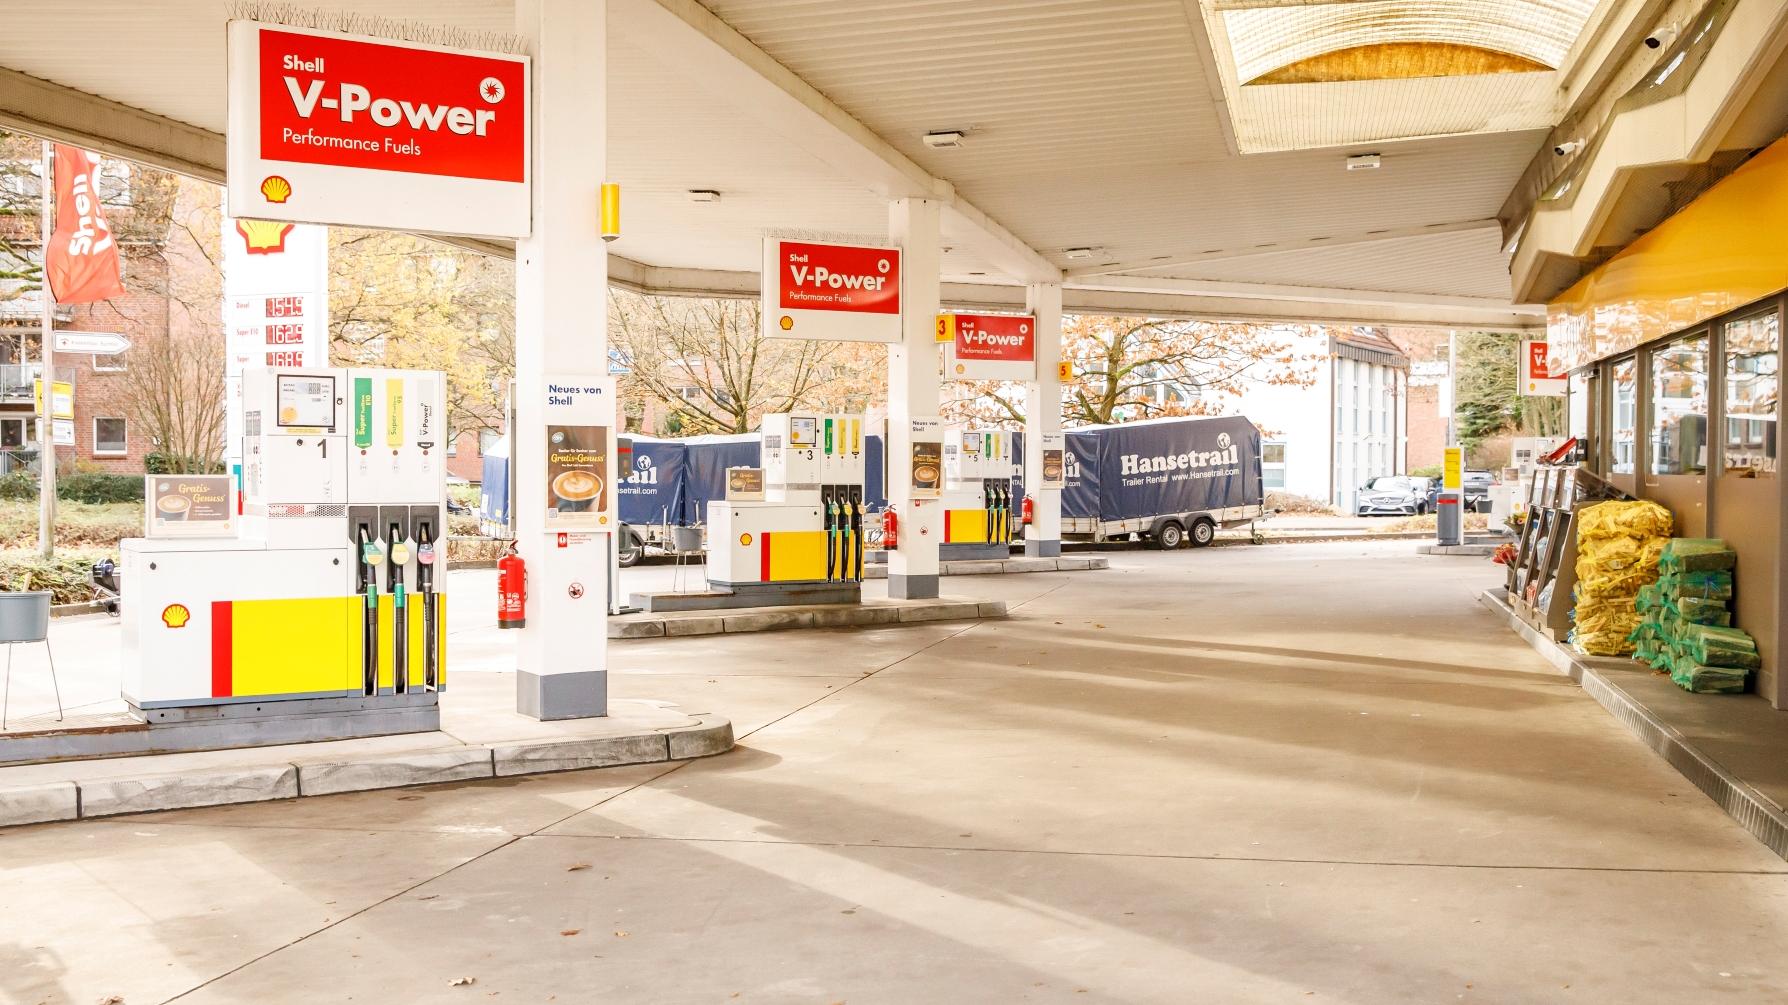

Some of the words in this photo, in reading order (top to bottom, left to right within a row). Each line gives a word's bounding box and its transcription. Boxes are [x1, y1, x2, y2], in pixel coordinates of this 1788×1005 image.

[283, 55, 325, 74] Shell
[282, 75, 496, 137] V-Power
[283, 127, 380, 152] Performance
[384, 137, 421, 156] Fuels
[68, 173, 96, 256] Shell
[789, 253, 809, 263] Shell
[789, 264, 886, 291] V-Power
[789, 291, 833, 302] Performance
[834, 293, 852, 303] Fuels
[938, 319, 946, 335] 3
[962, 330, 1025, 346] V-Power
[1060, 365, 1066, 376] 5
[548, 384, 580, 394] Neues
[583, 386, 602, 395] von
[548, 396, 573, 406] Shell
[317, 438, 327, 459] 1
[806, 450, 813, 461] 3
[1120, 444, 1239, 476] Hansetrail
[1121, 477, 1144, 487] Trailer
[1145, 474, 1168, 486] Rental
[1172, 466, 1240, 481] www.Hansetrail.com
